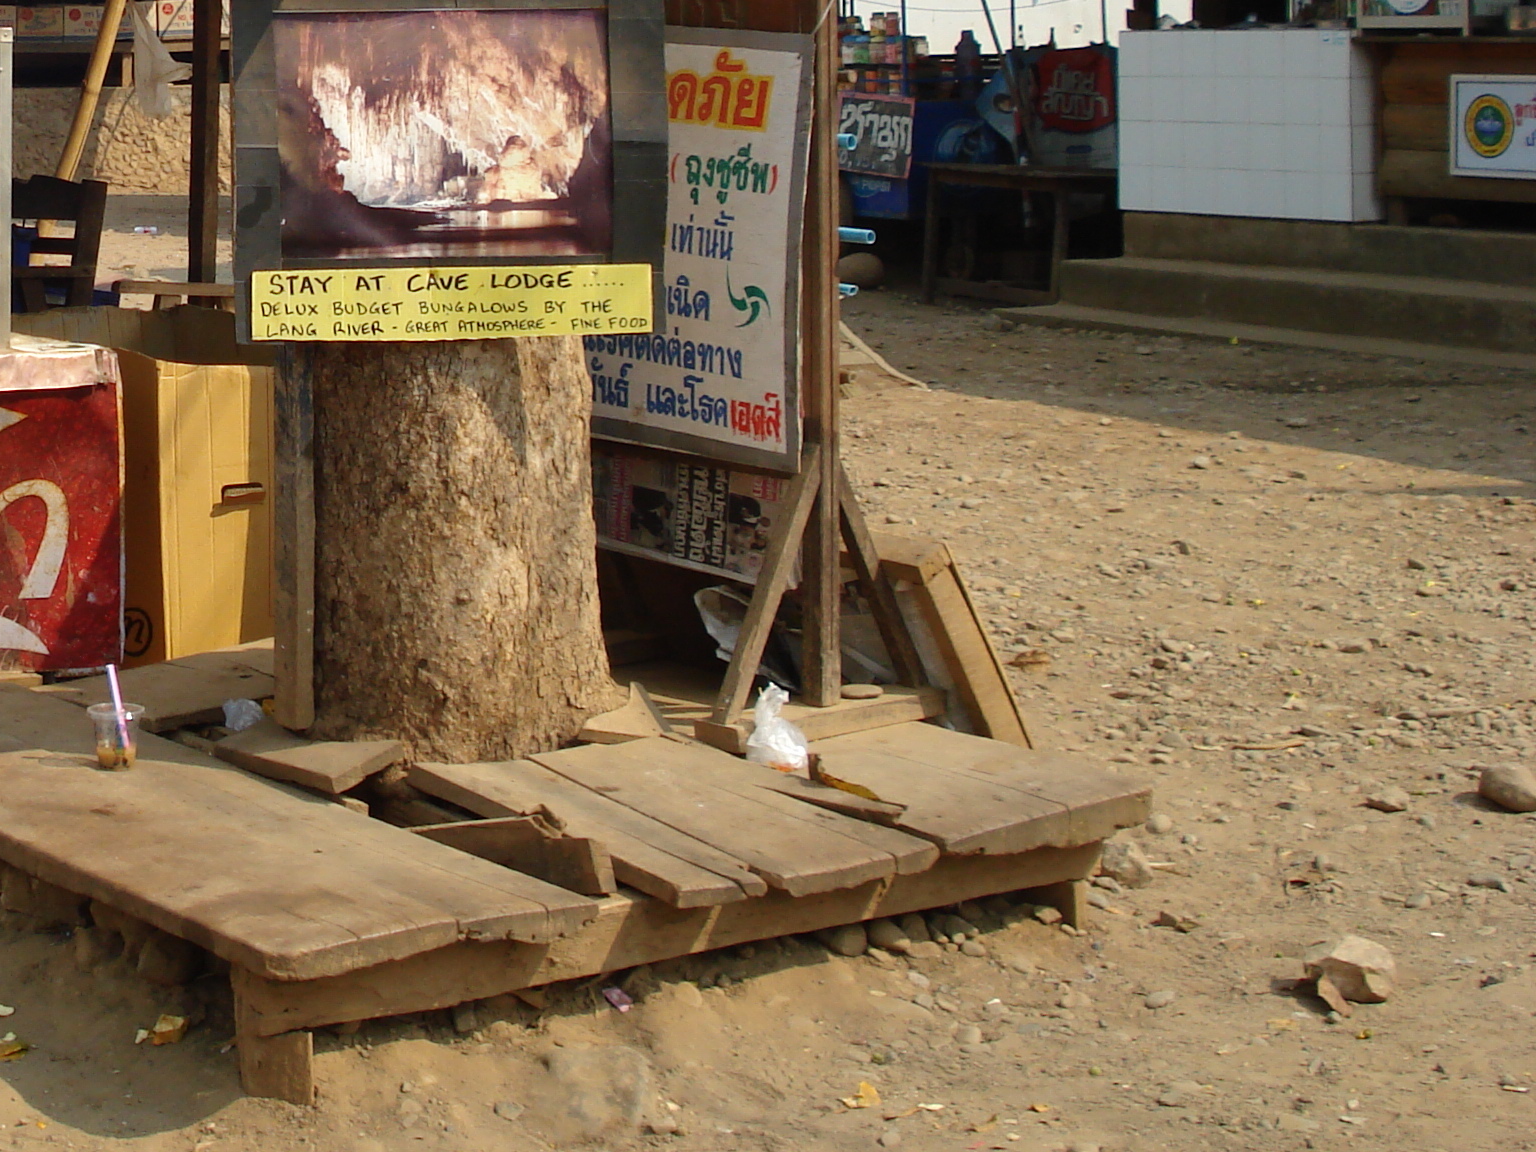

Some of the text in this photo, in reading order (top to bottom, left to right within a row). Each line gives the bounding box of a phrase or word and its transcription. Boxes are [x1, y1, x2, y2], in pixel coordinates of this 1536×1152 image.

[668, 51, 771, 129] ดภัย
[671, 211, 736, 262] เท่านั้น
[269, 274, 334, 295] STAY
[355, 274, 386, 292] AT
[406, 273, 470, 293] CAVE
[665, 275, 711, 321] เนิด
[260, 298, 613, 317] DELUX BUDGET BUNGALOWS BY THE
[265, 322, 318, 338] LANG
[332, 319, 385, 336] RIVER
[405, 319, 448, 334] GREAT
[457, 317, 546, 334] ATMOSPHERE
[570, 316, 602, 331] FINE
[608, 316, 649, 330] FOOD
[591, 355, 634, 410] ันธ์
